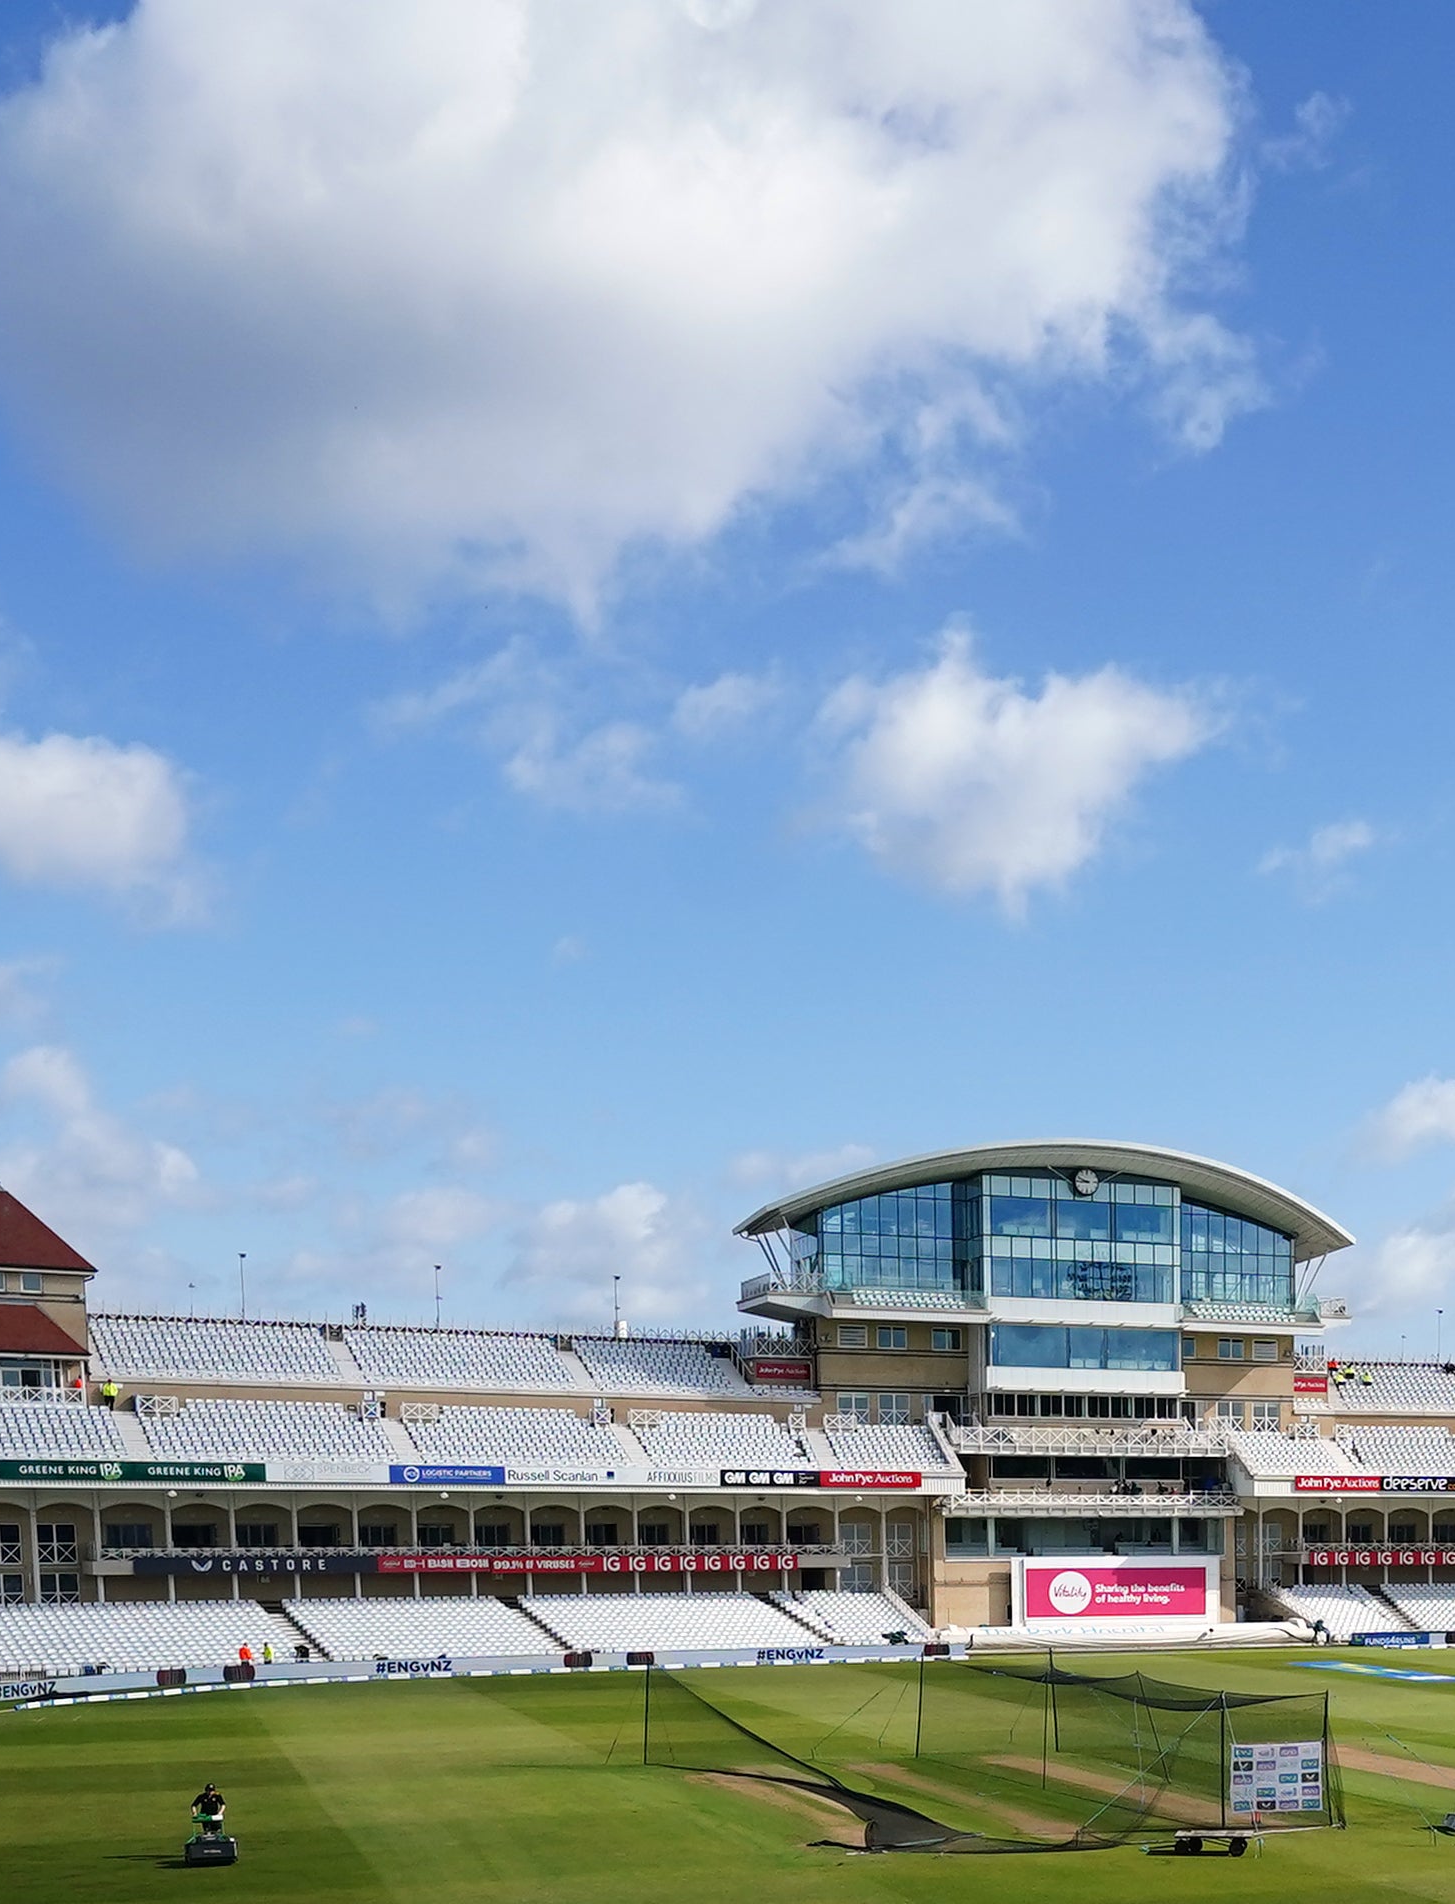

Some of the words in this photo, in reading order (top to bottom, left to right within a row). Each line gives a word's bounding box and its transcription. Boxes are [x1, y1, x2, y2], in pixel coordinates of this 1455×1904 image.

[19, 1465, 64, 1475] GREENE
[68, 1465, 97, 1475] KING
[99, 1462, 123, 1477] IPA
[147, 1466, 191, 1476] GREENE
[194, 1466, 221, 1476] KING
[223, 1464, 246, 1478] IPA
[421, 1469, 454, 1477] LOGISTIC
[455, 1469, 492, 1477] PARTNERS
[507, 1469, 550, 1481] Russell
[553, 1469, 598, 1482] Scanlan
[724, 1471, 746, 1484] GM
[748, 1471, 770, 1484] GM
[772, 1472, 794, 1485] GM
[828, 1472, 854, 1483] John
[854, 1473, 874, 1485] Pye
[874, 1473, 913, 1484] Auctions
[1297, 1477, 1323, 1488] John
[1323, 1478, 1341, 1490] Pye
[1341, 1478, 1380, 1489] Auctions
[222, 1559, 327, 1571] CASTORE
[536, 1559, 575, 1569] VIRUSES
[603, 1556, 620, 1571] IG
[628, 1556, 646, 1571] IG
[654, 1556, 671, 1571] IG
[679, 1556, 696, 1571] IG
[704, 1556, 721, 1570] IG
[729, 1555, 745, 1570] IG
[753, 1555, 770, 1570] IG
[777, 1555, 794, 1570] IG
[1313, 1552, 1329, 1565] IG
[1334, 1552, 1349, 1565] IG
[1356, 1552, 1371, 1565] IG
[1377, 1552, 1393, 1565] IG
[1399, 1552, 1414, 1565] IG
[1421, 1552, 1436, 1565] IG
[1053, 1585, 1087, 1601] Vitality
[1095, 1584, 1130, 1595] Sharing
[1131, 1583, 1145, 1593] the
[1147, 1582, 1185, 1593] benefits
[1095, 1594, 1106, 1604] of
[1107, 1593, 1141, 1606] healthy
[1143, 1592, 1171, 1605] living.
[1027, 1626, 1072, 1636] Park
[1364, 1636, 1416, 1645] FUNDS4RUNS
[756, 1647, 824, 1661] #ENGvNZ
[375, 1659, 453, 1674] #ENGvNZ
